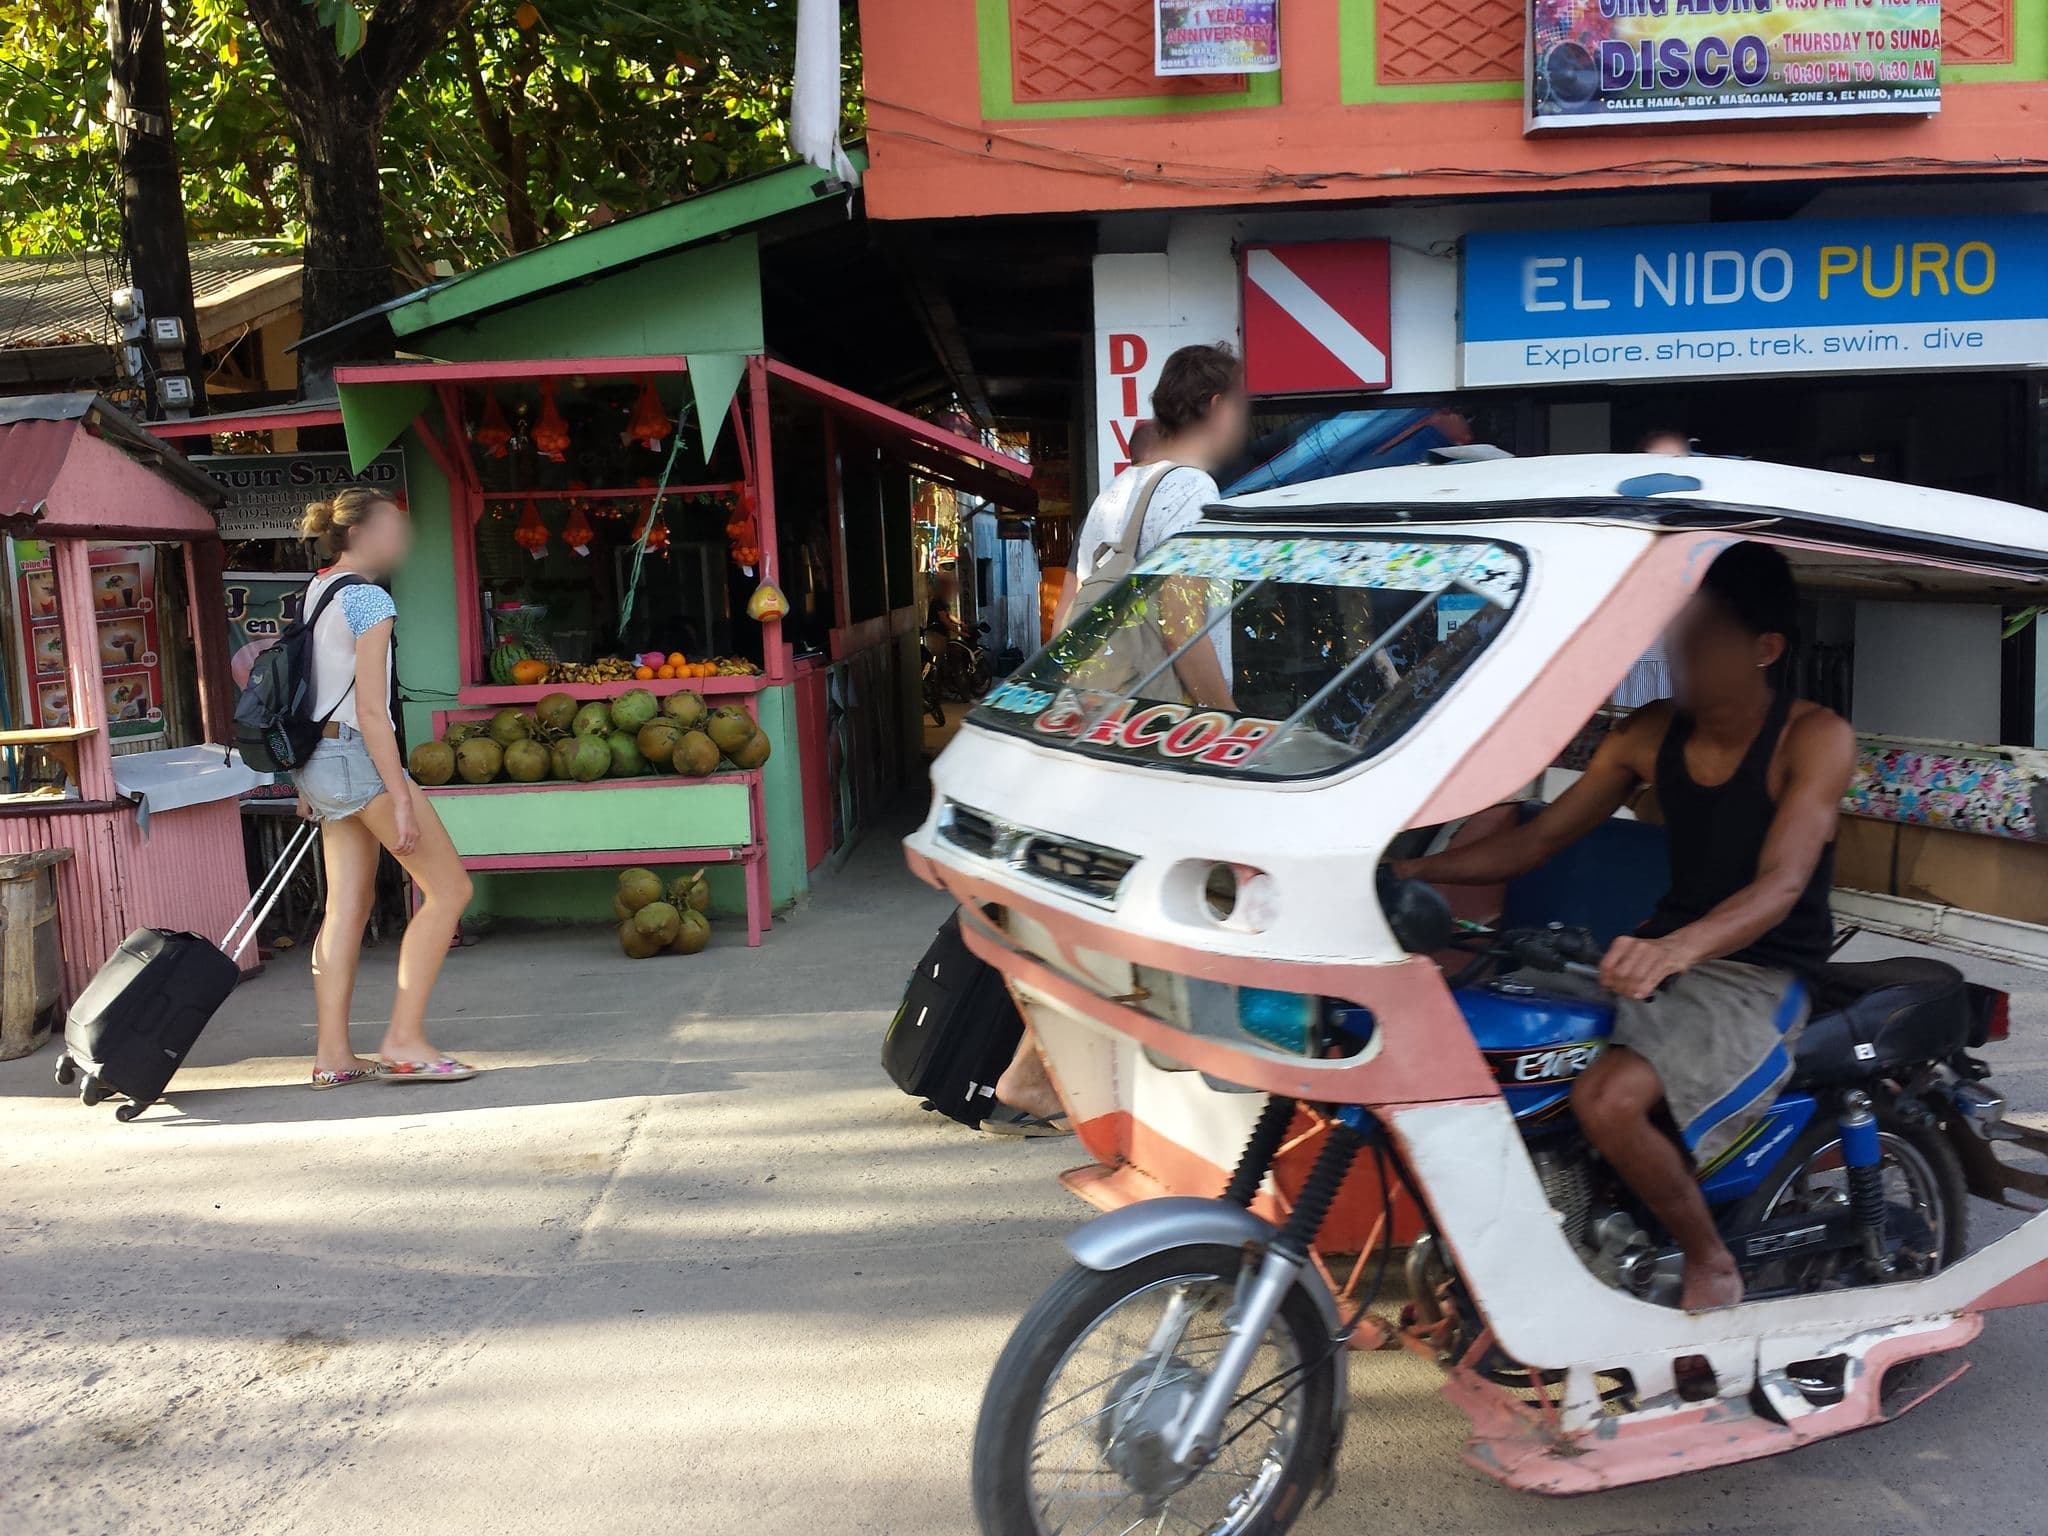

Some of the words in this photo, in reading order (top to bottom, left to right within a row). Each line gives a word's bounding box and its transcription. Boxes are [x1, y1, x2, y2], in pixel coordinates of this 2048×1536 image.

[1193, 11, 1201, 24] 1
[1206, 8, 1246, 23] YEAR
[1166, 24, 1273, 44] ANNIVERSARY
[1783, 32, 1862, 52] THURSDAY
[1866, 31, 1886, 50] TO
[1890, 29, 1941, 49] SUNDA
[1600, 35, 1769, 91] DISCO
[1784, 63, 1824, 84] 10:30
[1828, 62, 1850, 82] PM
[1854, 62, 1875, 81] TO
[1879, 61, 1908, 80] 1:30
[1913, 59, 1935, 79] AM
[1607, 100, 1644, 109] CALLE
[1647, 97, 1686, 108] HAMA,
[1720, 92, 1788, 104] MASAGANA,
[1791, 92, 1824, 102] ZONE
[1826, 91, 1837, 102] 3,
[1840, 90, 1855, 100] EL
[1858, 89, 1891, 100] NIDO,
[1894, 88, 1941, 98] PALAWA
[1525, 256, 1611, 312] EL
[1633, 248, 1793, 307] NIDO
[1819, 241, 1996, 300] PURO
[1526, 343, 1649, 369] Explore.
[1656, 339, 1742, 363] shop.
[1750, 334, 1813, 355] trek.
[1824, 330, 1908, 352] swim.
[1924, 328, 1983, 348] dive
[1109, 334, 1152, 477] DIV
[204, 469, 282, 488] RUIT
[218, 522, 259, 531] alawan,
